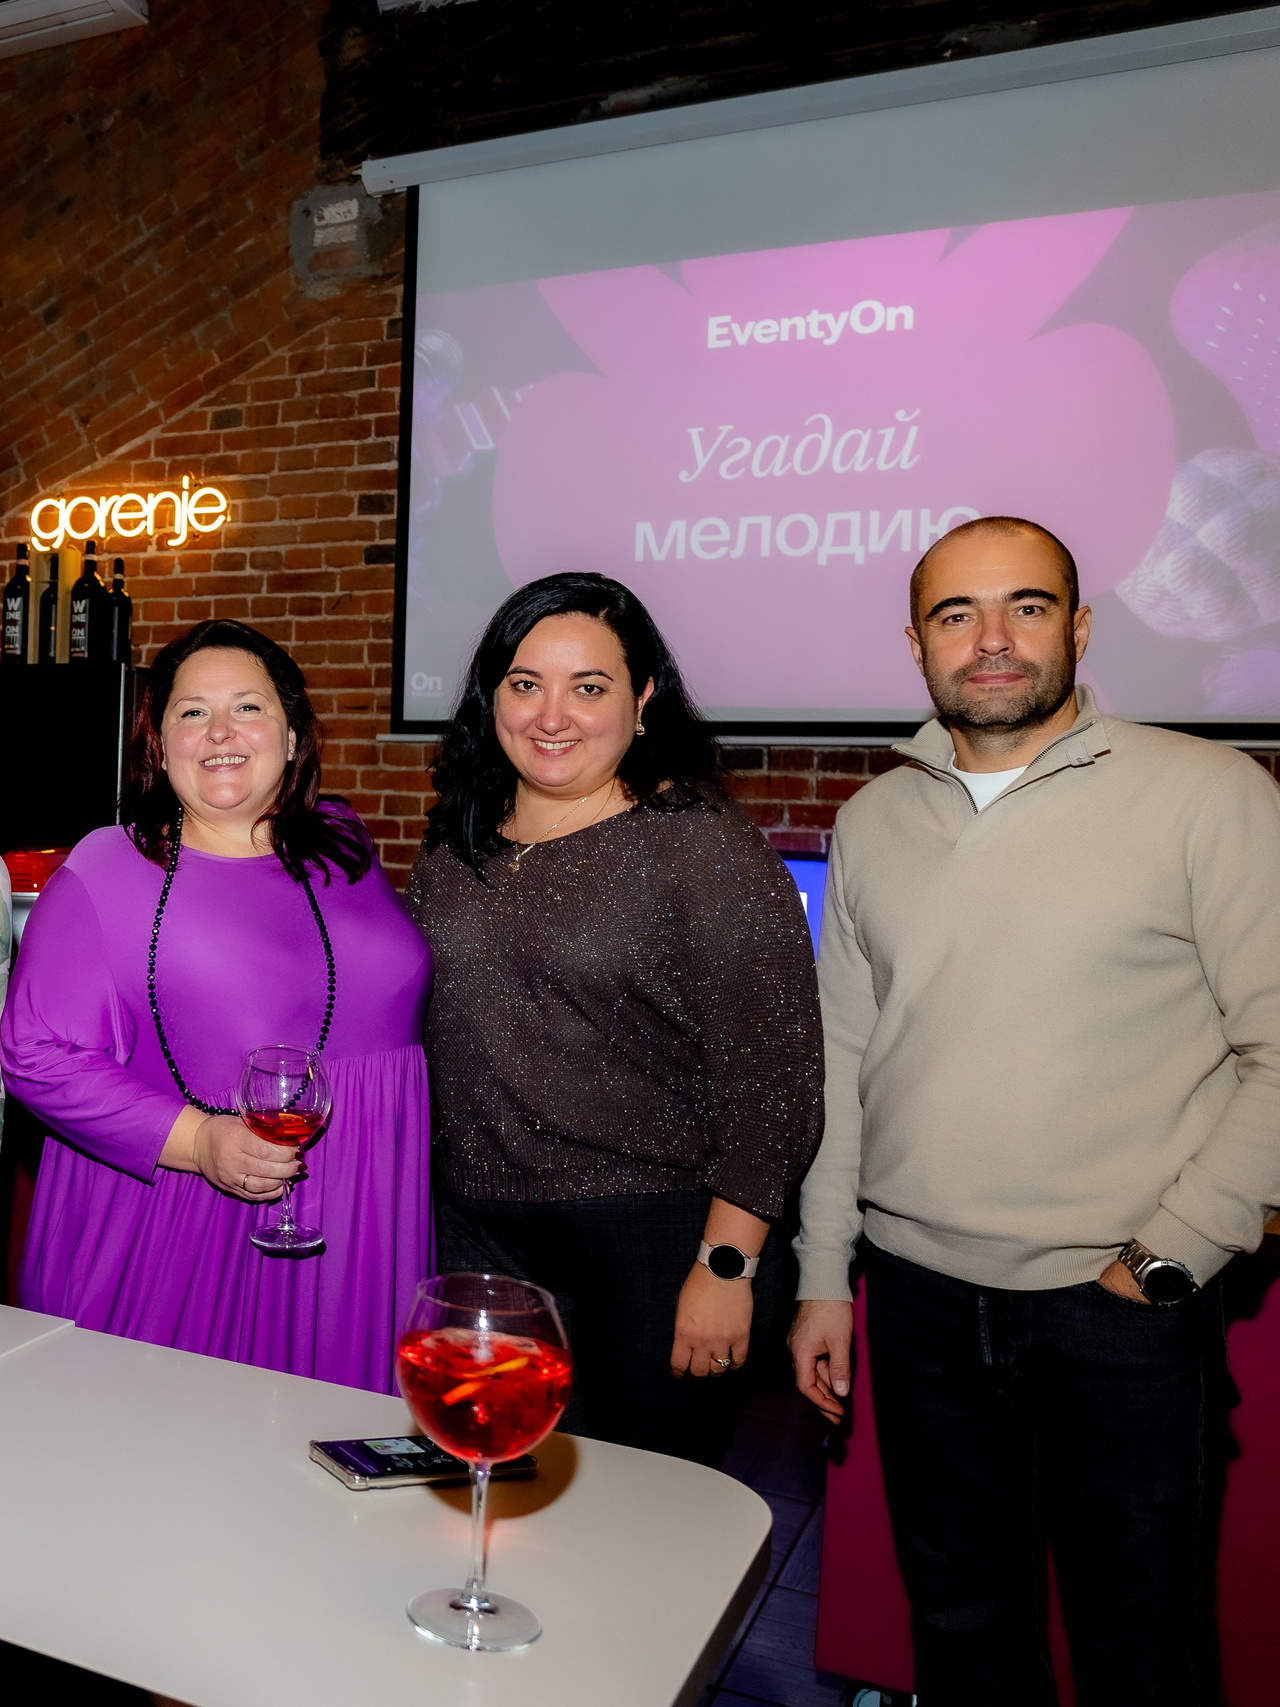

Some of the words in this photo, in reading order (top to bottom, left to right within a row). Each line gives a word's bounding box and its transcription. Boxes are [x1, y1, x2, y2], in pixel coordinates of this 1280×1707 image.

[707, 299, 915, 349] EventyOn
[678, 407, 921, 483] Угадай
[30, 474, 228, 552] gorenje
[410, 672, 443, 691] On
